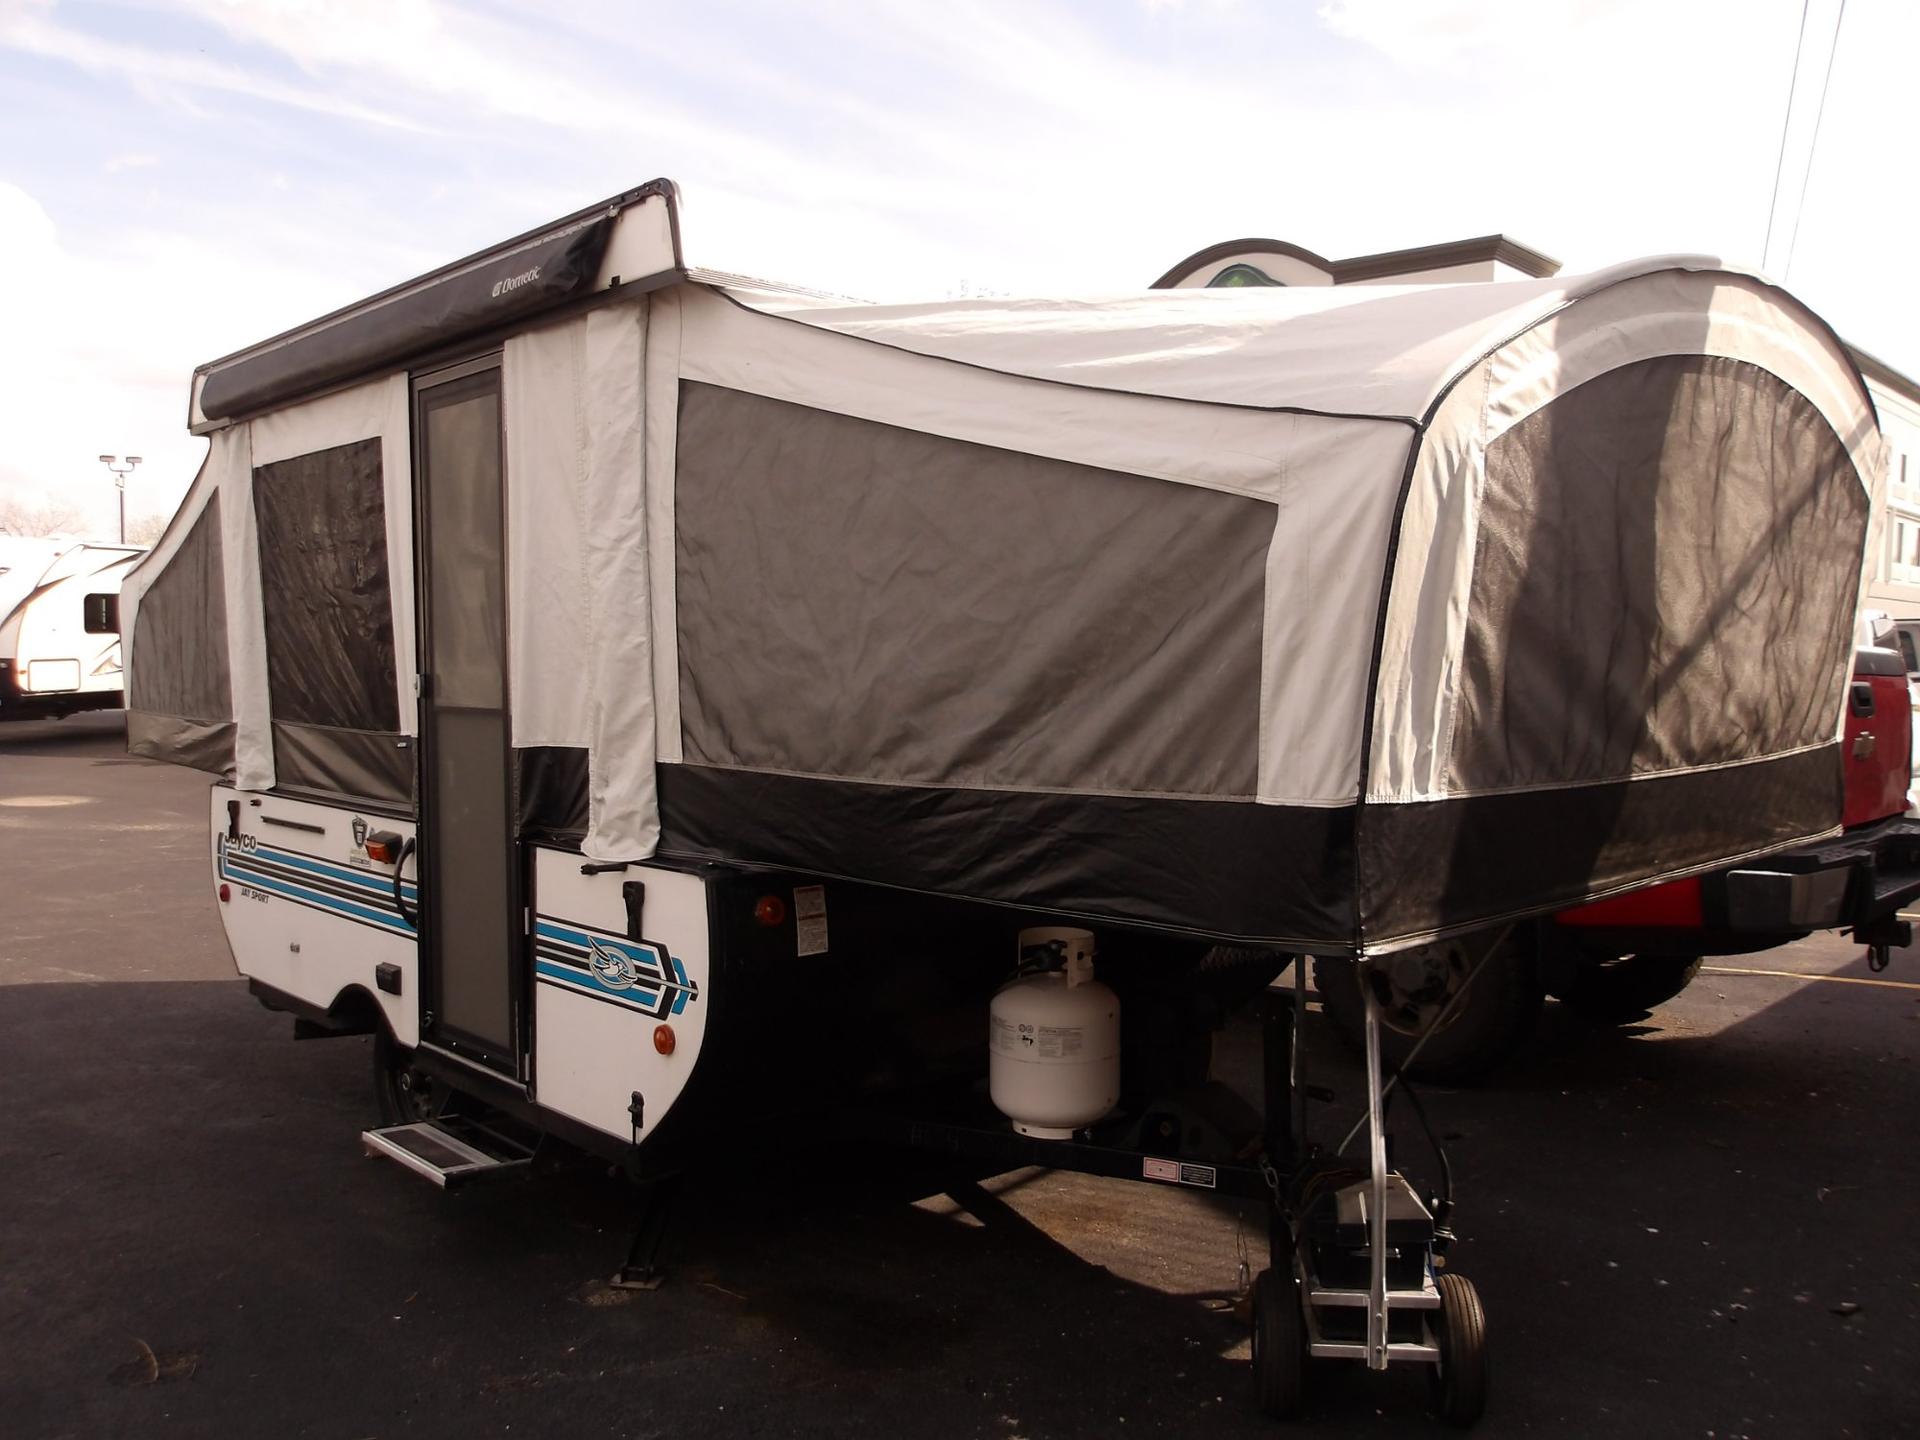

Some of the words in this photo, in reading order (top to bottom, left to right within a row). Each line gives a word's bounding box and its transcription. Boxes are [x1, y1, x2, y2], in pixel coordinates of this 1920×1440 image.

[502, 266, 541, 293] Dometic
[241, 887, 250, 897] JAY
[251, 890, 269, 904] SPORT
